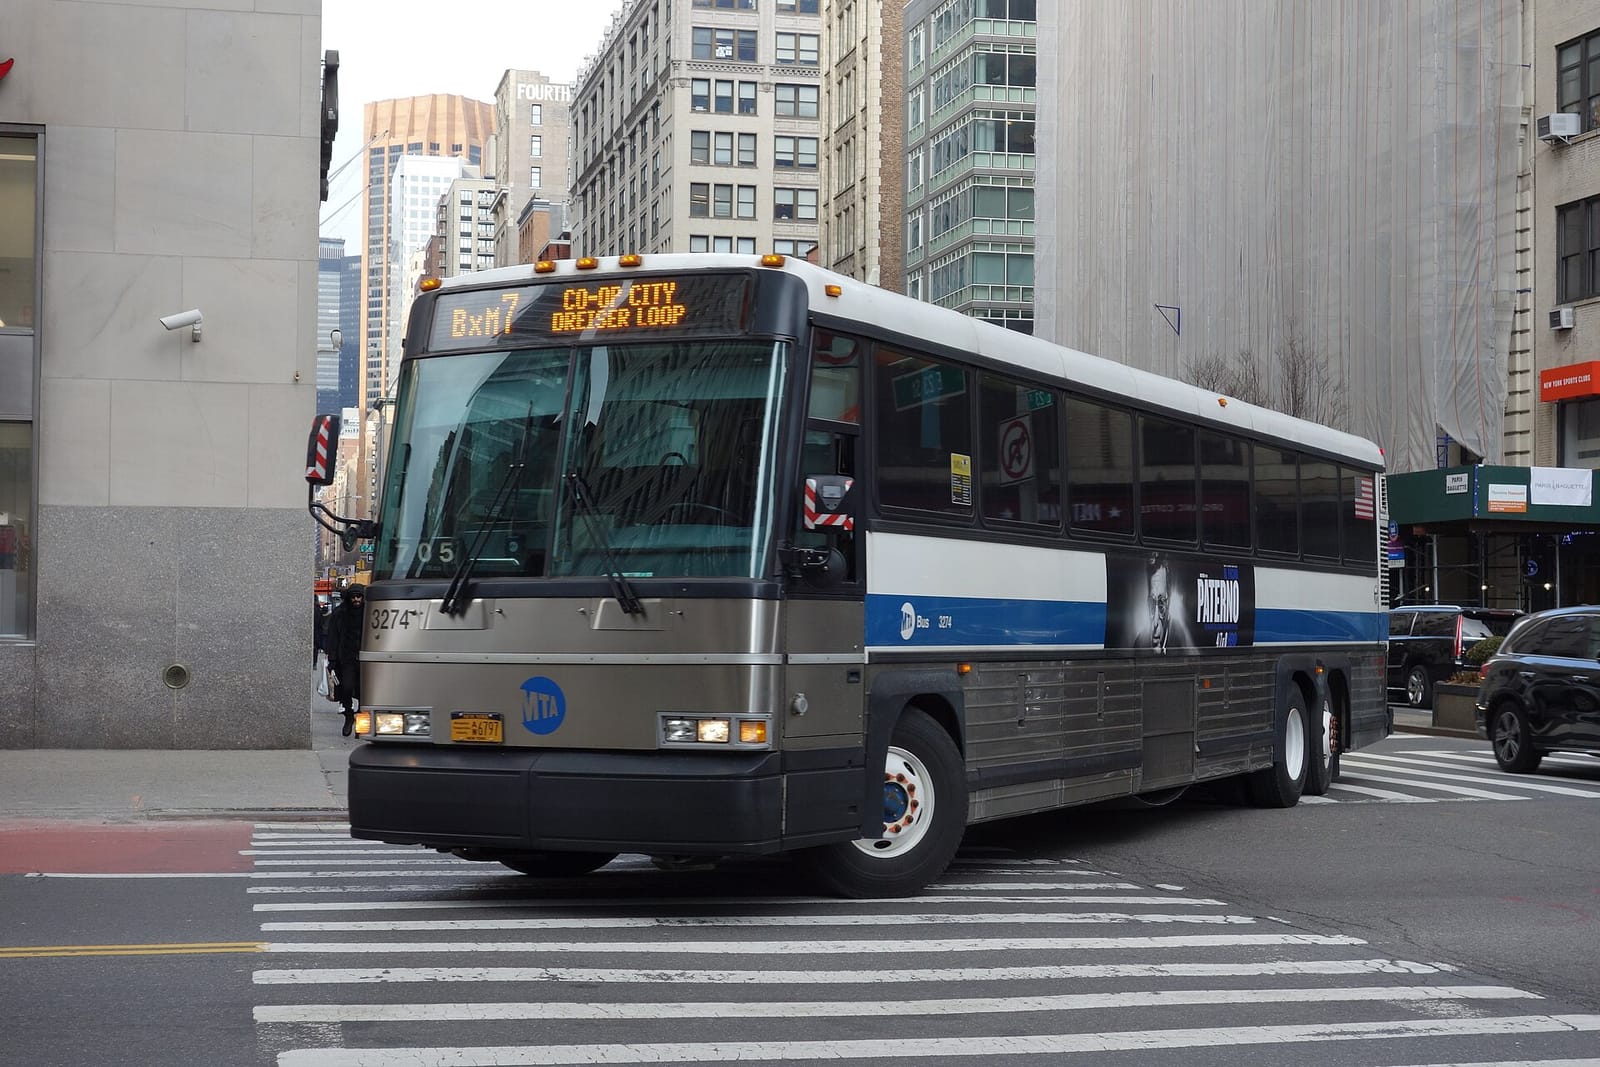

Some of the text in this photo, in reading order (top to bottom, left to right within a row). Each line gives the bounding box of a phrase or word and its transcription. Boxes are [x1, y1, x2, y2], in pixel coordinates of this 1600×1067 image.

[517, 84, 571, 101] FOURTH
[563, 282, 676, 310] CO-OP CITY
[452, 293, 519, 337] BxM7
[552, 305, 686, 331] DREISER LOOP
[1543, 374, 1591, 389] NEW YORK SPORTS CLUBS
[396, 542, 454, 563] 705
[1197, 579, 1239, 623] PATERNO
[371, 609, 409, 630] 3274
[917, 615, 929, 628] Bus
[938, 615, 952, 628] 3274
[520, 686, 560, 724] MTA
